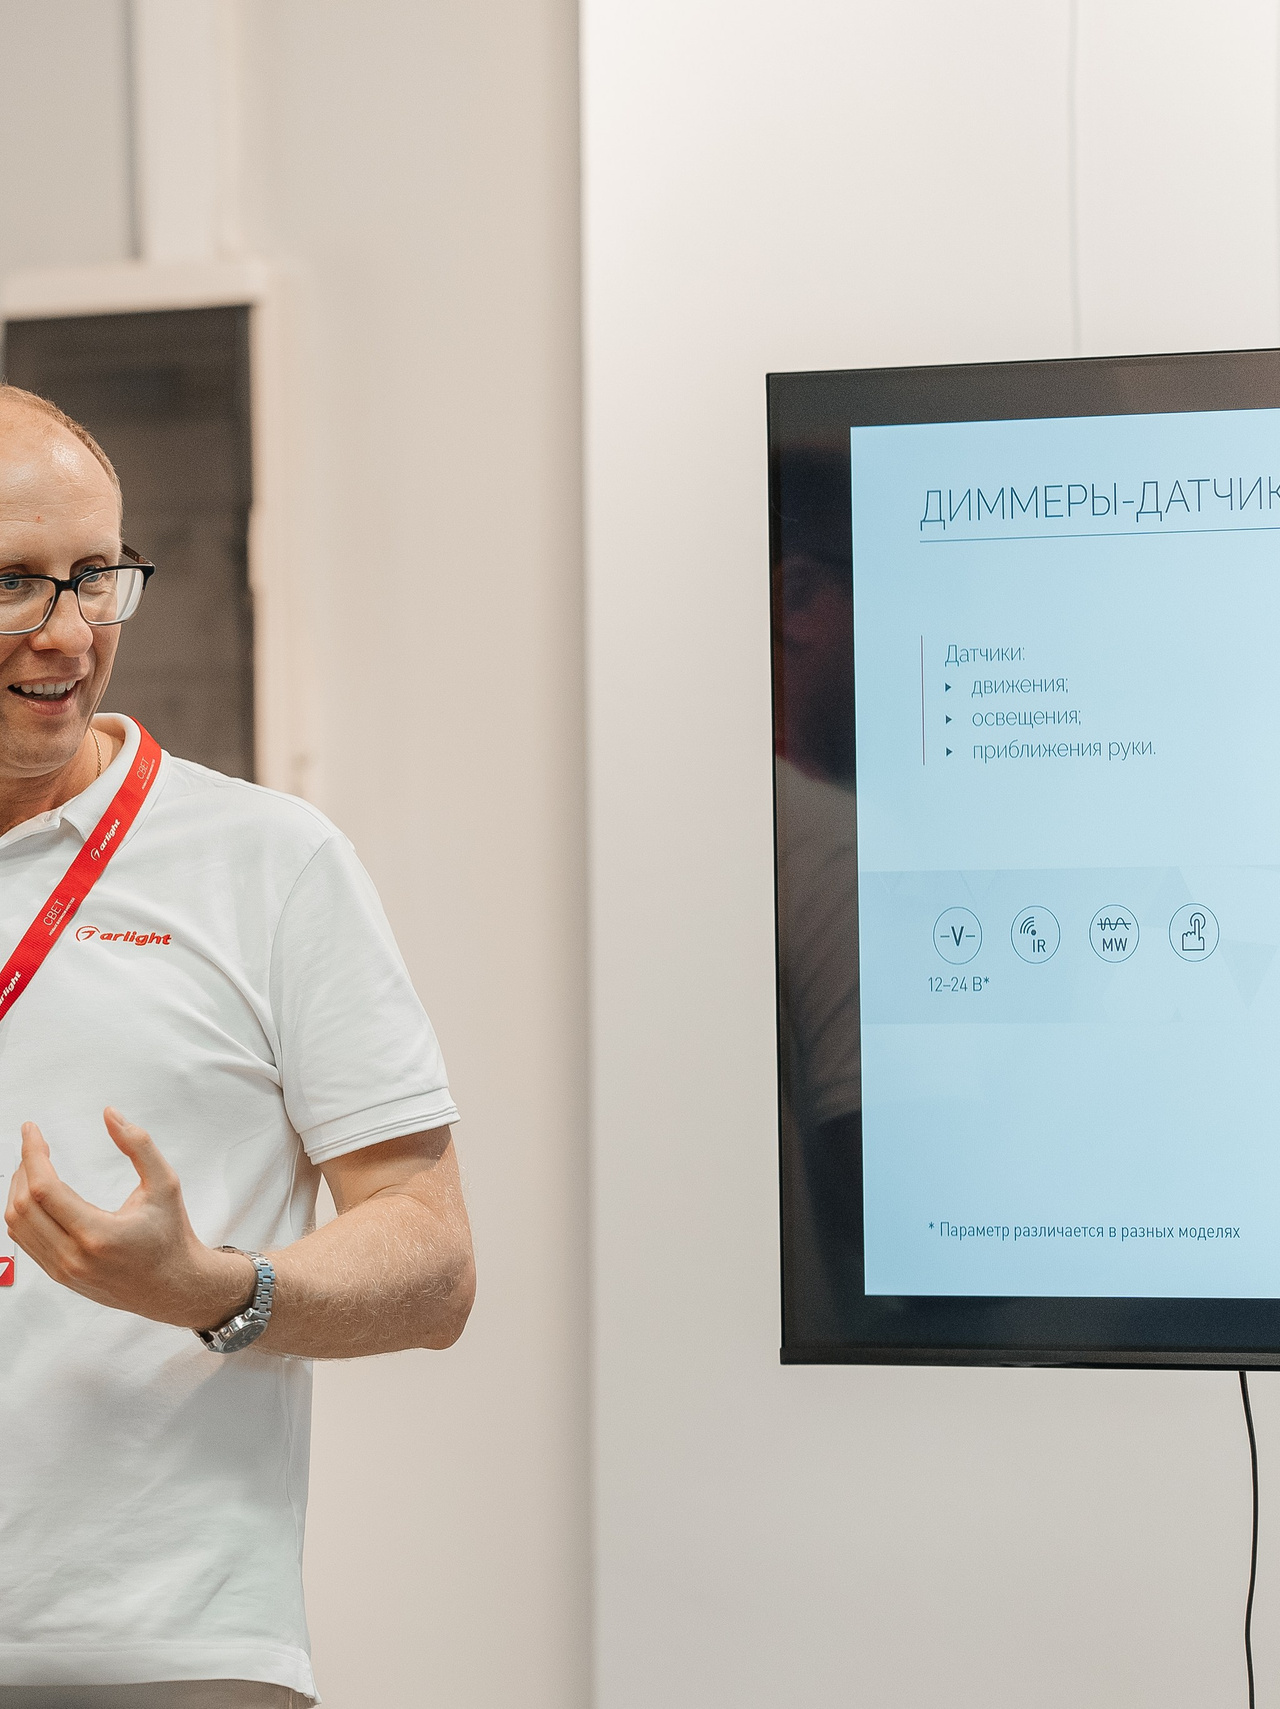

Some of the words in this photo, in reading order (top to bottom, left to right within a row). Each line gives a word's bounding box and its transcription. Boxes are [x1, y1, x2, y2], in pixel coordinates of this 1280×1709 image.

[919, 475, 1280, 531] ДИММЕРЫ-ДАТЧИК
[944, 643, 1026, 667] Датчики:
[970, 676, 1070, 698] движения;
[971, 707, 1083, 728] освещения;
[972, 739, 1103, 763] приближения
[1108, 740, 1157, 761] руки.
[99, 818, 121, 852] arlight
[99, 931, 172, 946] arlight
[1031, 938, 1047, 953] IR
[1101, 937, 1128, 952] MW
[939, 1221, 1010, 1241] Параметр
[1013, 1223, 1105, 1241] различается
[1108, 1225, 1117, 1238] в
[1120, 1225, 1175, 1241] разных
[1178, 1225, 1241, 1240] моделях
